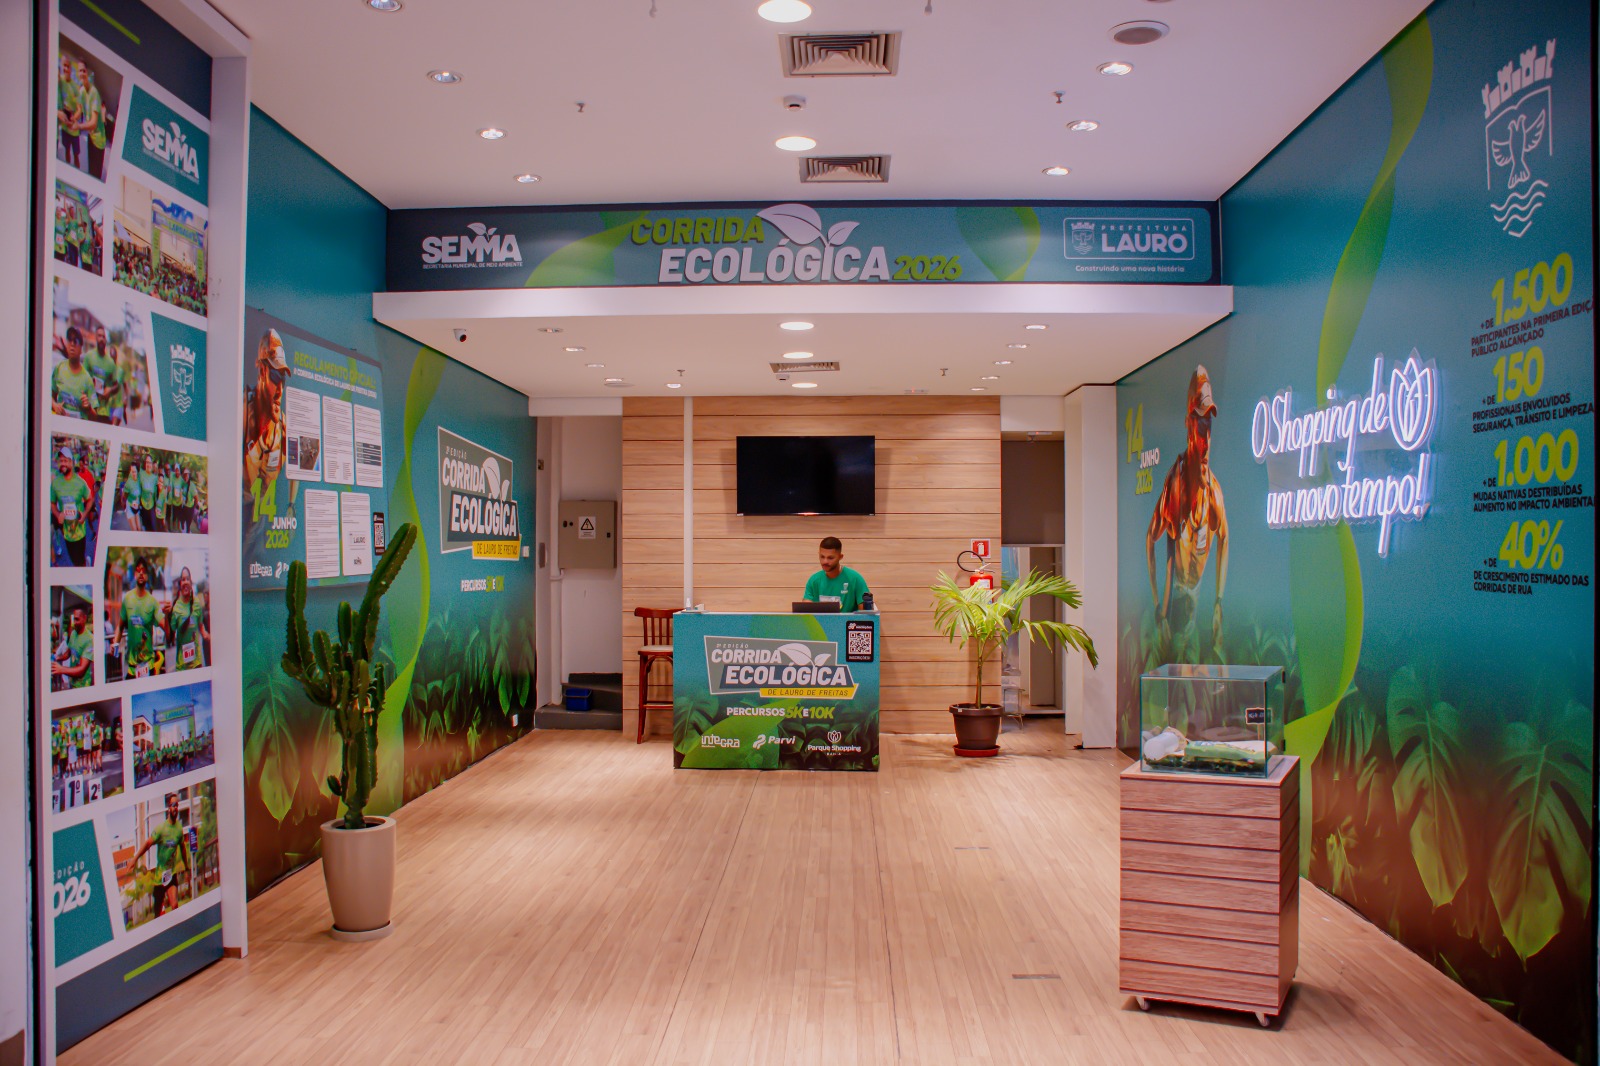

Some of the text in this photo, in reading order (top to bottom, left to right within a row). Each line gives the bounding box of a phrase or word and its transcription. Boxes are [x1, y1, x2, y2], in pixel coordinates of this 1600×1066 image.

[142, 118, 199, 179] SEMMA
[632, 217, 765, 245] CORRIDA
[1102, 233, 1188, 253] LAURO
[422, 234, 522, 263] SEMMA
[658, 238, 963, 283] ECOLÓGICA 2026
[1486, 318, 1494, 328] DE
[1491, 252, 1573, 326] 1.500
[1472, 300, 1593, 346] PARTICIPANTES NA PRIMEIRA EDIÇ
[1500, 328, 1544, 350] ALCANÇADO
[294, 352, 348, 380] REGULAMENTO
[1487, 395, 1495, 405] DE
[1492, 346, 1545, 403] 150
[1252, 358, 1390, 478] O Shopping de
[1473, 393, 1570, 422] PROFISSIONAIS ENVOLVIDOS
[1473, 402, 1594, 433] SEGURANÇA, TRÂNSITO E LIMPEZA
[1125, 402, 1143, 464] 14
[1140, 448, 1160, 469] JUNHO
[1488, 478, 1496, 487] DE
[1494, 429, 1579, 486] 1.000
[442, 457, 485, 494] CORRIDA
[1135, 467, 1153, 495] 2026
[250, 478, 277, 522] 14
[1267, 453, 1428, 554] um novo tempo!
[1474, 482, 1582, 501] MUDAS NATIVAS DESTRIBUÍDAS
[1474, 496, 1595, 512] AUMENTO NO IMPACTO AMBIENTA
[272, 516, 297, 530] JUNHO
[451, 492, 517, 536] ECOLÓGICA
[265, 529, 290, 548] 2026
[476, 543, 483, 554] DE
[1488, 558, 1497, 567] DE
[1498, 520, 1564, 570] 40%
[461, 579, 486, 592] PERCURSOS
[1474, 571, 1589, 586] DE CRESCIMENTO ESTIMADO DAS
[1474, 582, 1532, 595] CORRIDAS DE RUA
[711, 649, 782, 664] CORRIDA
[725, 662, 847, 686] ECOLÓGICA
[726, 706, 836, 719] PERCURSOS 5K E 10K
[768, 735, 796, 745] Parvi
[69, 780, 80, 807] 1º
[91, 783, 100, 800] 2º
[54, 861, 85, 879] DIÇÃO
[53, 871, 91, 918] 026
